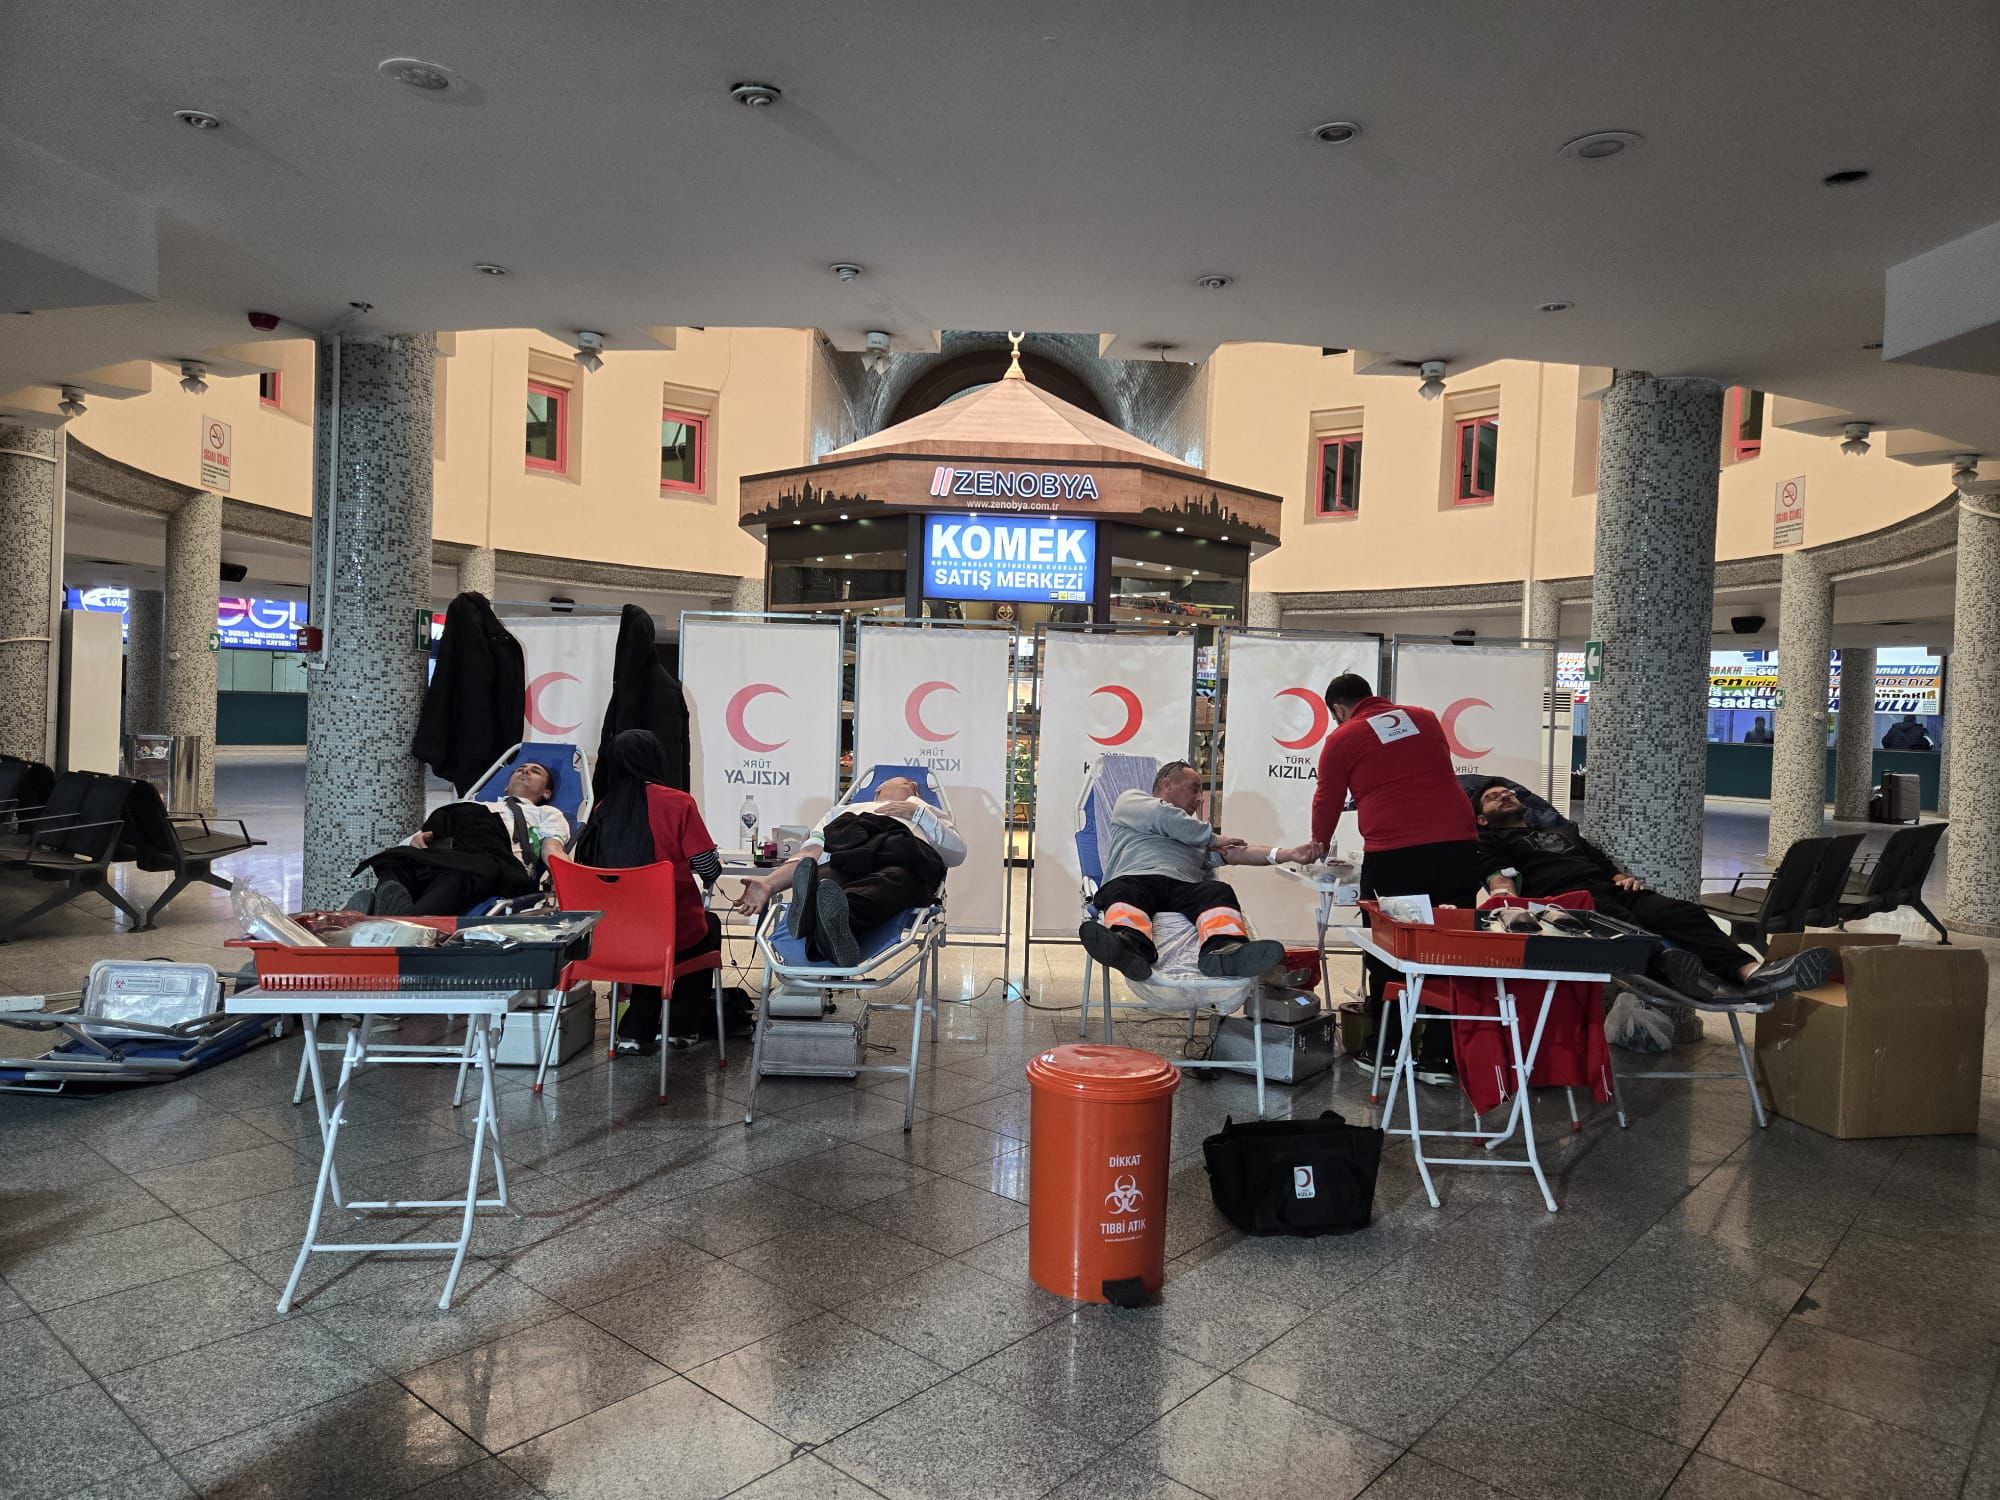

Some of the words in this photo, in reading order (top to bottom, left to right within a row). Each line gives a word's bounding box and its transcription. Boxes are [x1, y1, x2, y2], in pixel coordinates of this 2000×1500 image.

[952, 470, 1099, 500] ZENOBYA
[966, 500, 1061, 512] www.zenobya.com.tr
[931, 524, 1088, 564] KOMEK
[935, 568, 992, 590] SATIŞ
[1284, 755, 1311, 765] TÜRK
[1268, 764, 1318, 780] KIZILA
[1109, 1154, 1142, 1168] DİKKAT
[1100, 1220, 1126, 1235] TIBBİ
[1128, 1219, 1146, 1233] ATIK
